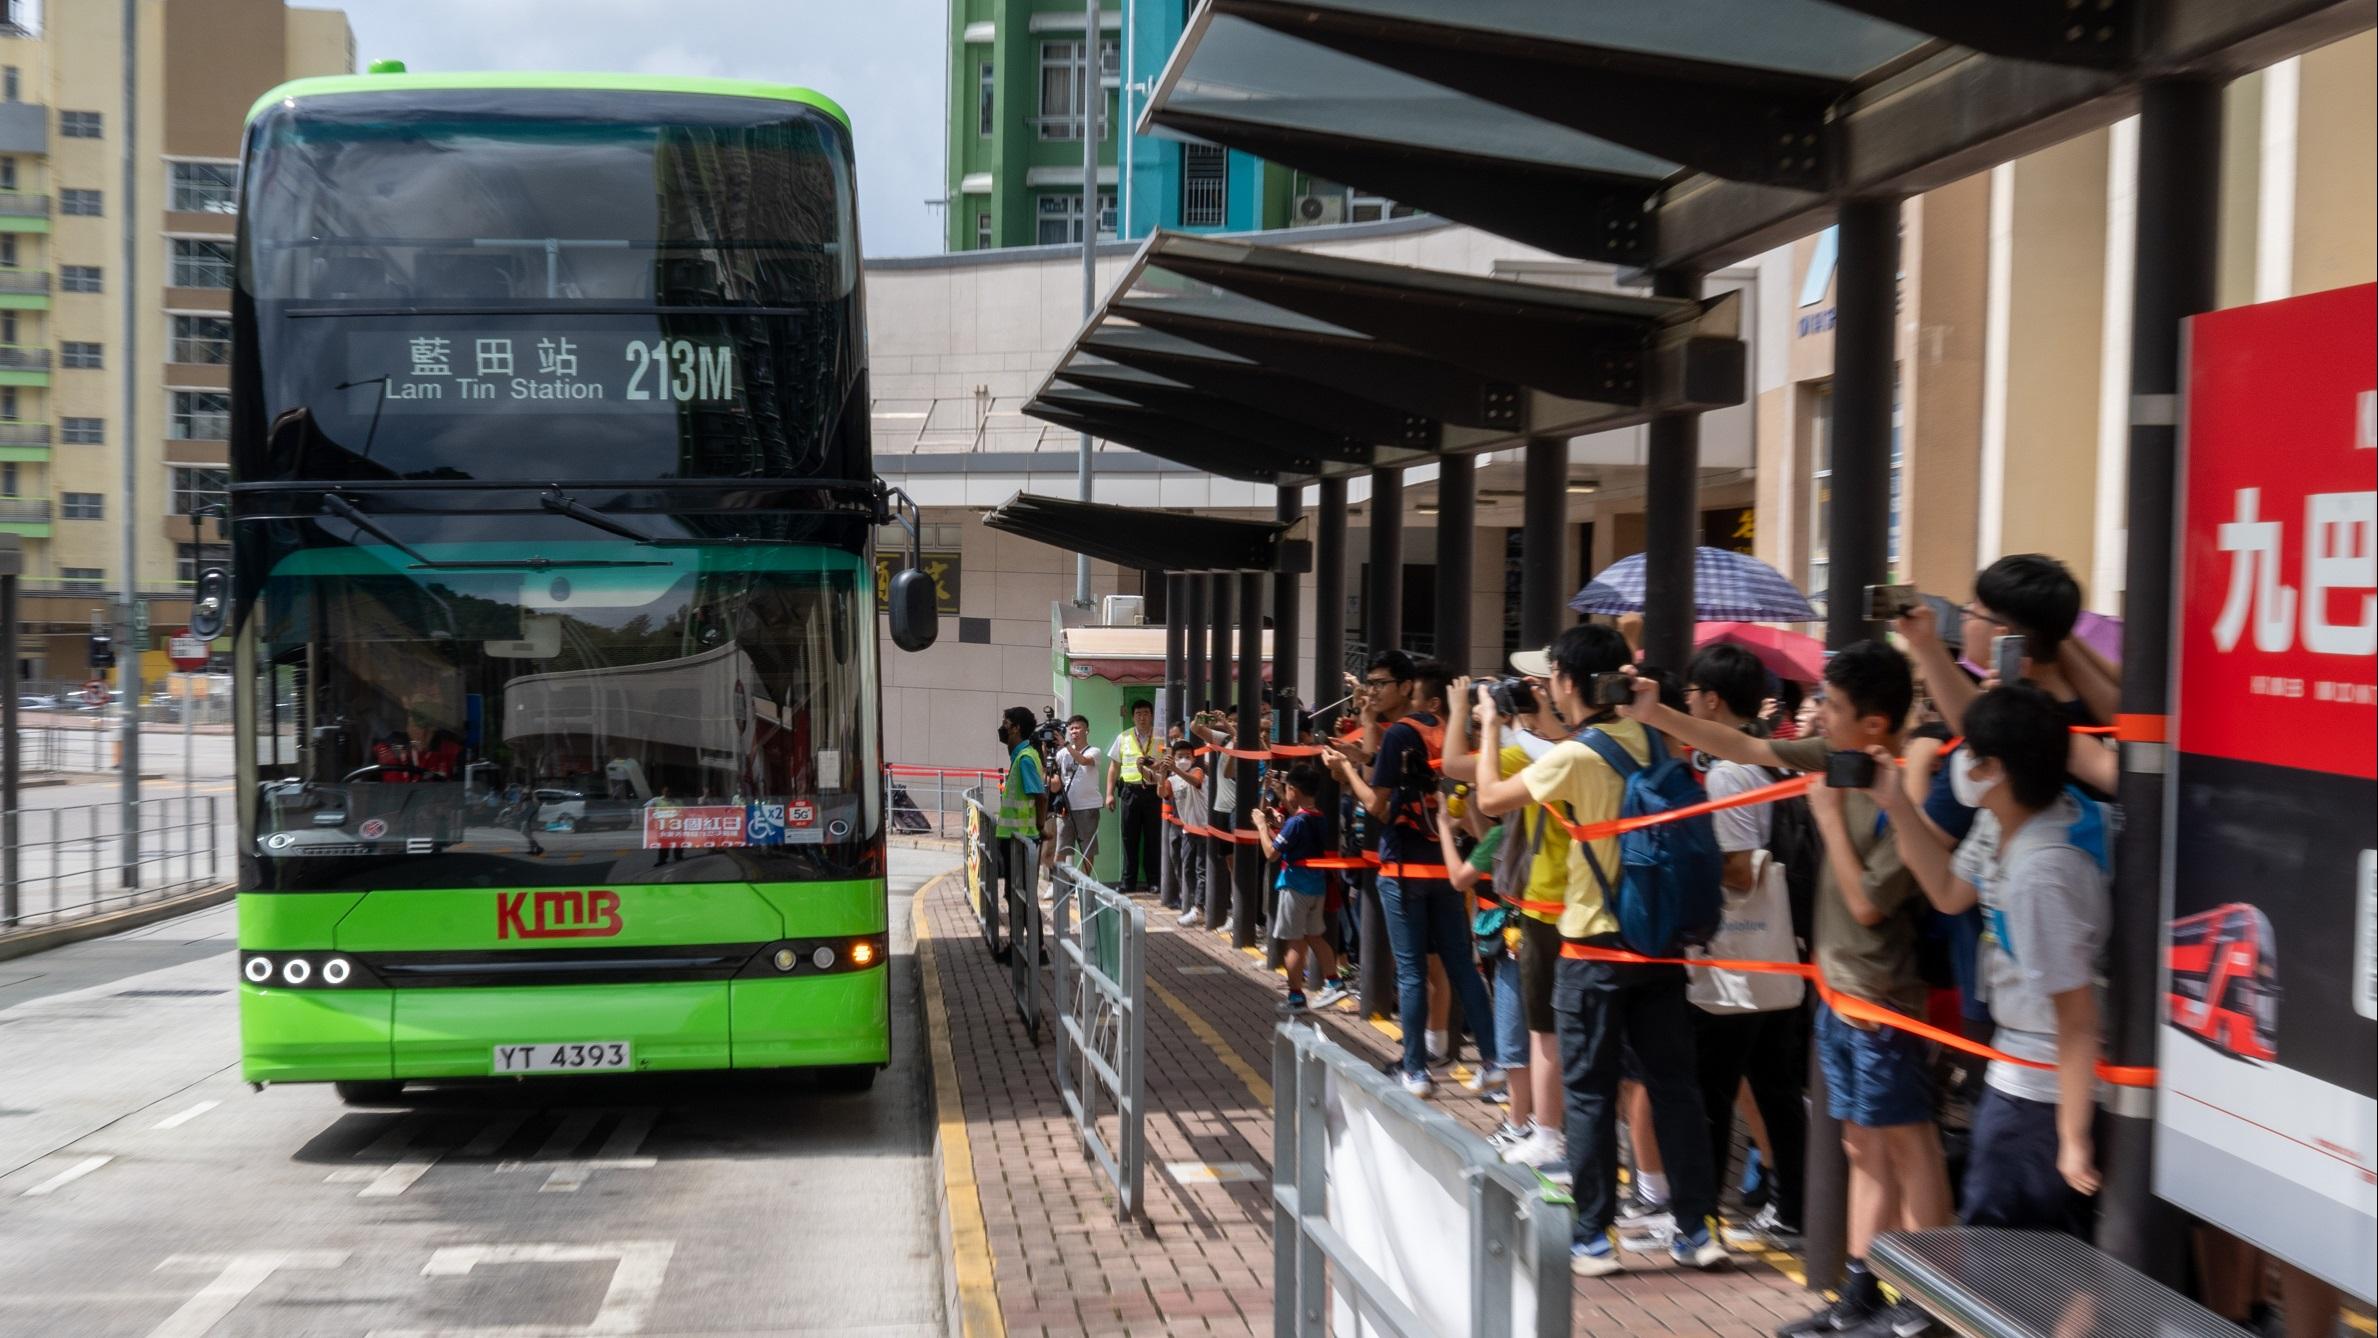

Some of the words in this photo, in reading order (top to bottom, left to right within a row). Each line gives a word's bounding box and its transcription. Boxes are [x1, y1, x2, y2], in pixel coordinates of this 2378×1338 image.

[409, 337, 578, 377] 藍田站
[625, 339, 732, 401] 213M
[386, 378, 441, 400] Lam
[456, 377, 496, 400] Tin
[510, 377, 603, 400] Station
[2211, 487, 2377, 656] 九巴
[497, 890, 623, 940] KMB
[499, 1046, 535, 1070] YT
[550, 1044, 624, 1067] 4393
